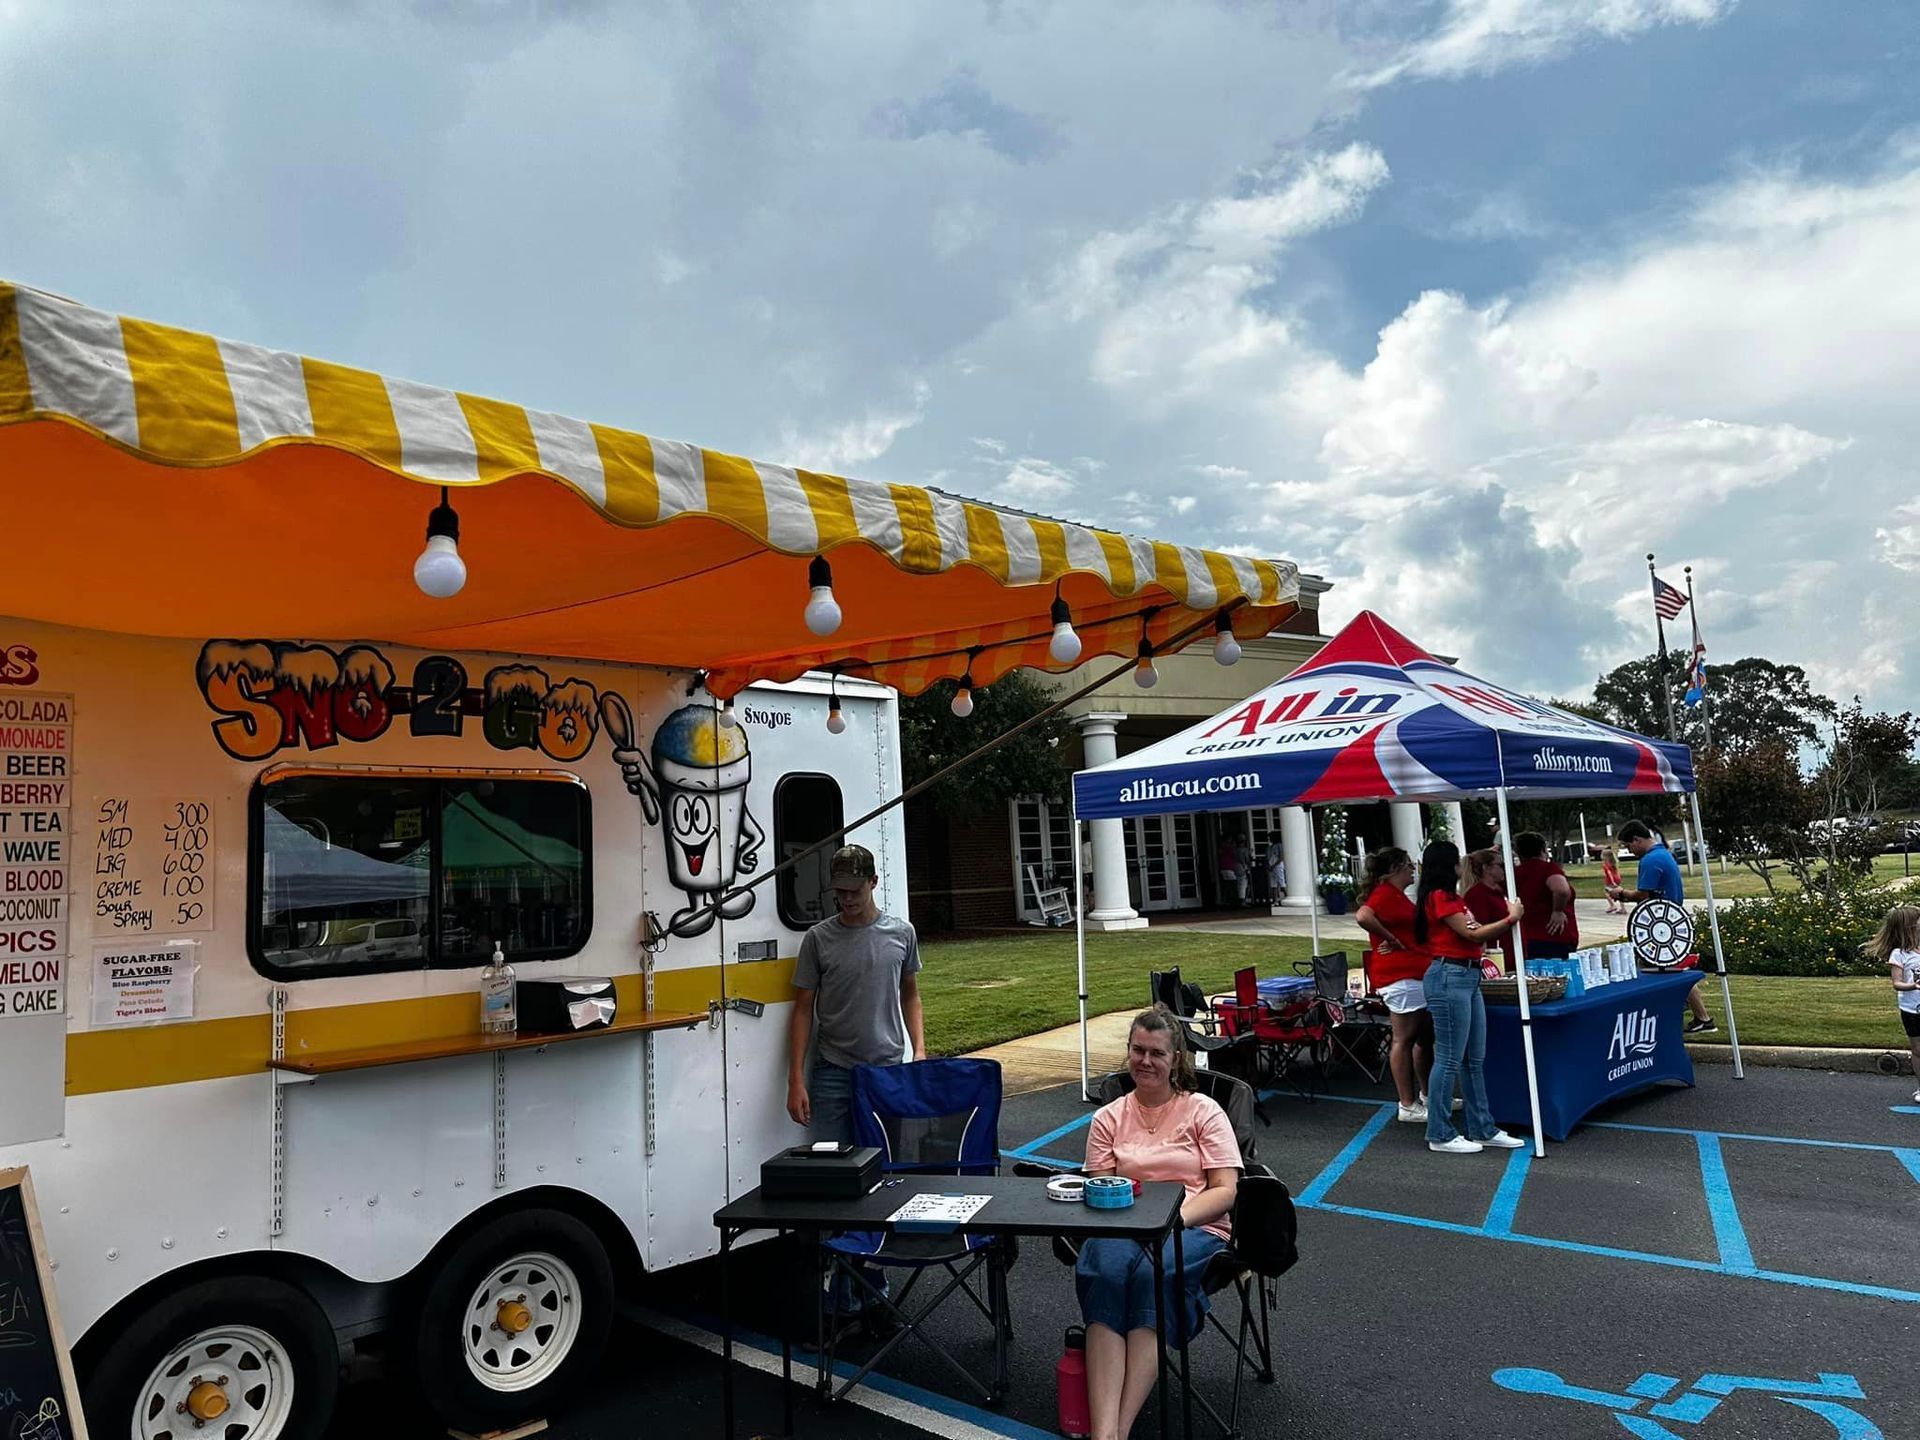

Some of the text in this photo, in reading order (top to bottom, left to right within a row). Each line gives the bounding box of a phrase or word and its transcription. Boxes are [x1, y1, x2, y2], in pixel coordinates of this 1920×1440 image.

[1198, 687, 1402, 739] All in
[1186, 724, 1368, 755] CREDIT UNION
[6, 754, 66, 776] BEER
[1533, 747, 1613, 773] allincu.com
[1, 783, 64, 805] BERRY
[1119, 771, 1262, 803] allincu.com
[20, 812, 61, 832] TEA
[98, 799, 128, 823] SM
[97, 827, 132, 851] MED
[4, 841, 60, 862] WAVE
[96, 852, 126, 878] LRG
[6, 870, 63, 892] BLOOD
[97, 875, 204, 899] CREME 1.00
[171, 902, 203, 925] .50
[102, 952, 181, 965] SUGAR-FREE
[111, 965, 173, 978] FLAVORS:
[13, 989, 57, 1013] CAKE
[1607, 1008, 1657, 1060] All in
[1608, 1056, 1654, 1081] CREDIT UNION
